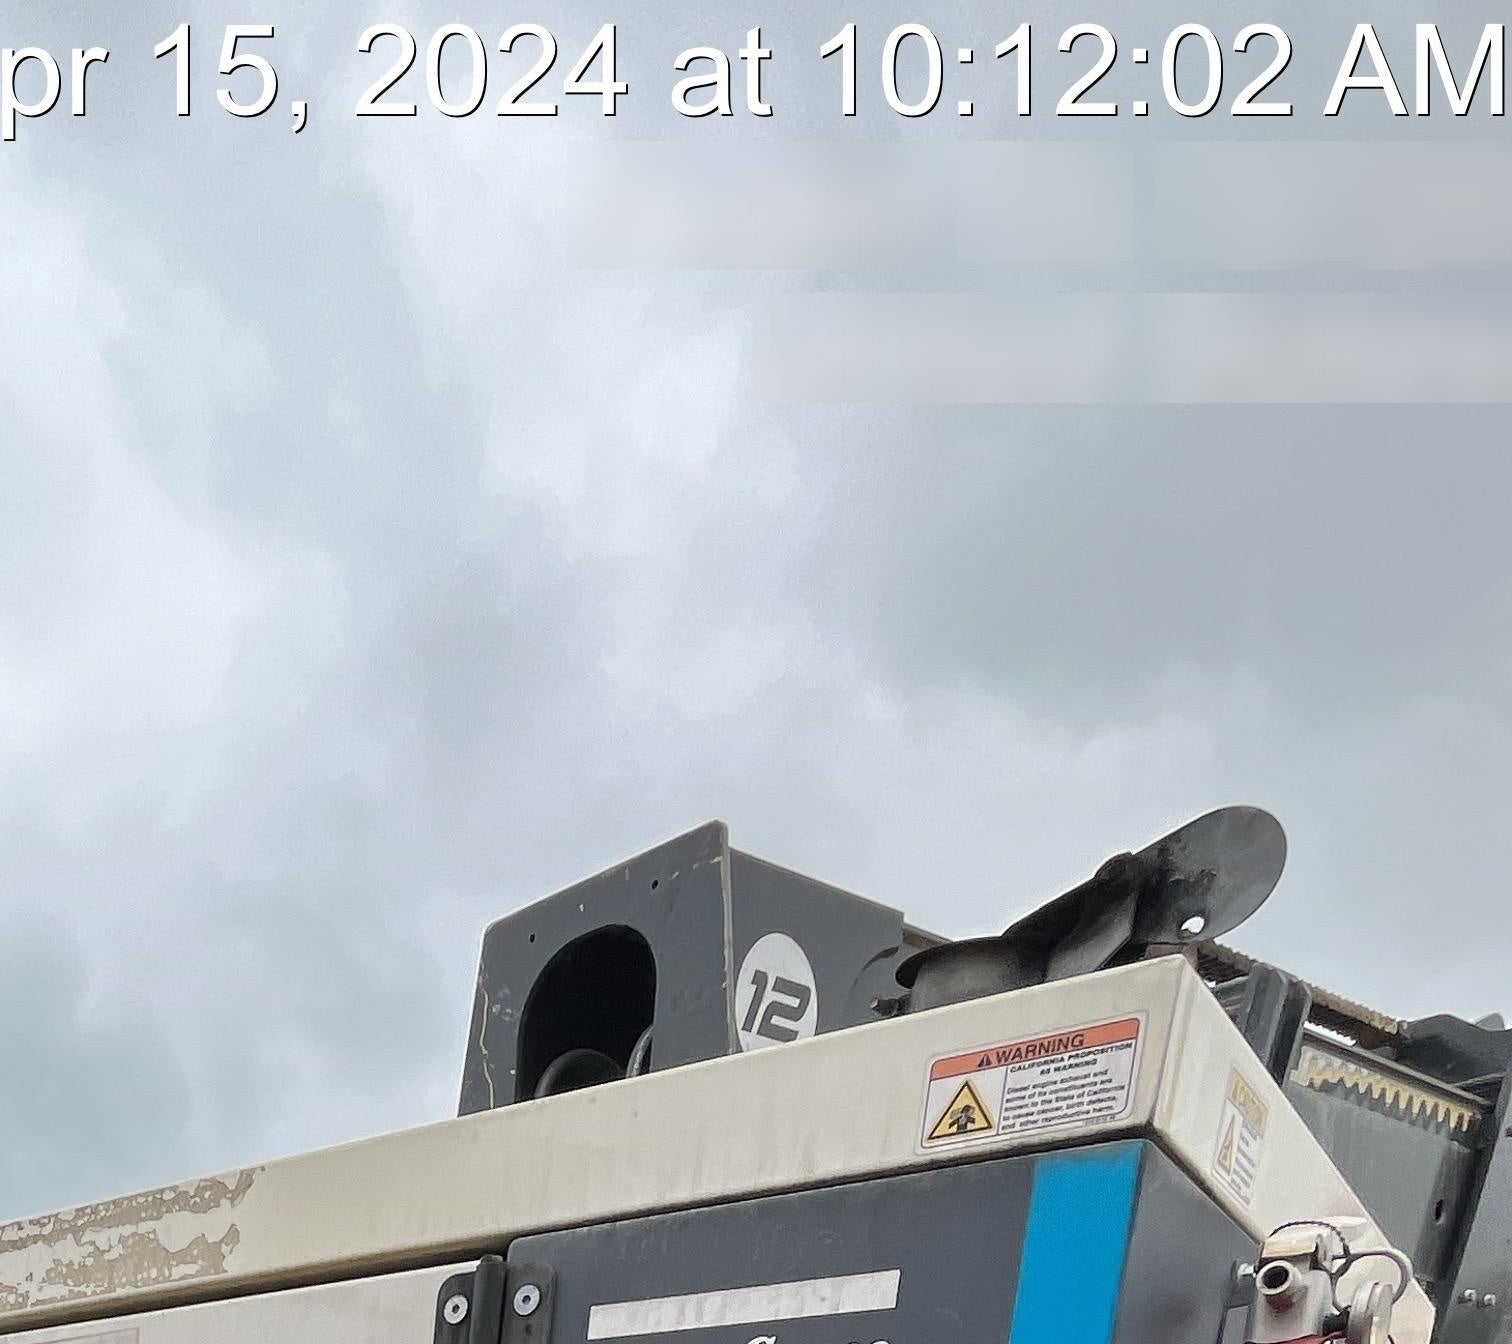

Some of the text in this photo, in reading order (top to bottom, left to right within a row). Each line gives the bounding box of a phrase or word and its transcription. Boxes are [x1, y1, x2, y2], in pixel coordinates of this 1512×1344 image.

[741, 969, 811, 1043] 12
[996, 1034, 1084, 1064] WARNING
[1010, 1056, 1065, 1073] CALIFORNIA
